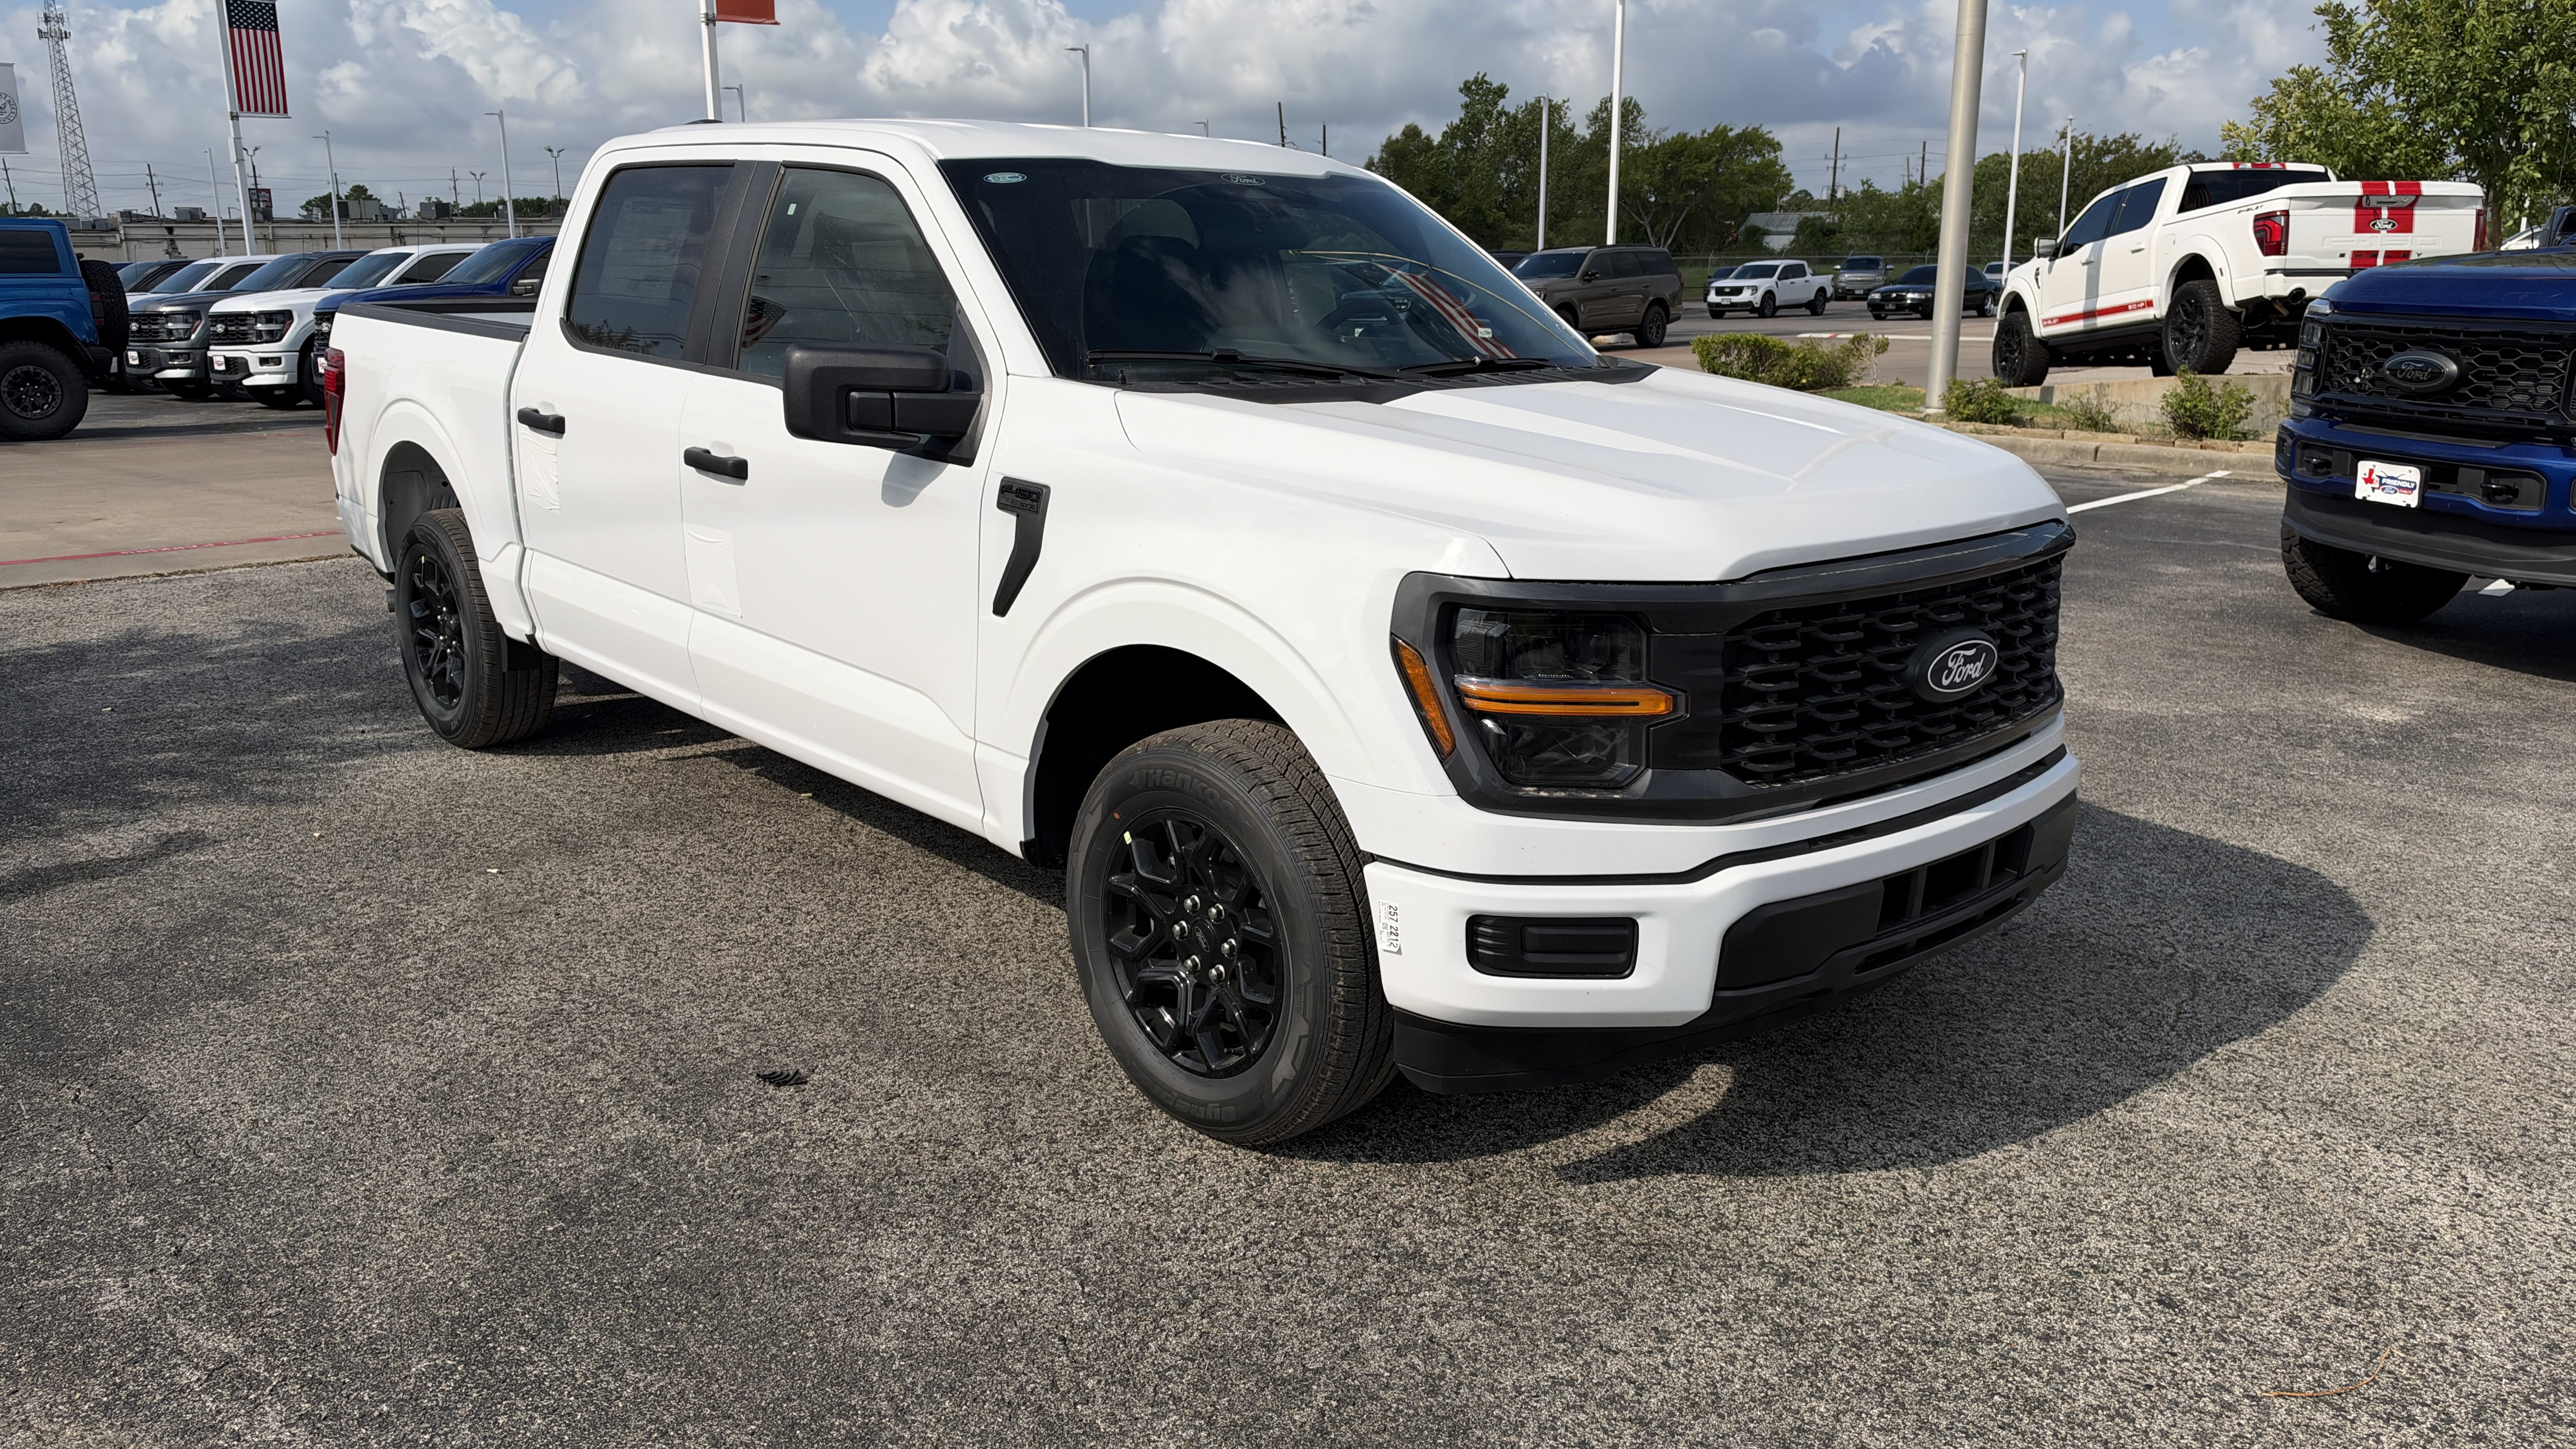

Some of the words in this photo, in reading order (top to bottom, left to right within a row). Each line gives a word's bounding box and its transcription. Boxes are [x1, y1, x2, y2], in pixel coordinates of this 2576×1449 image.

[1229, 175, 1258, 184] Ford
[2374, 221, 2393, 229] Ford
[2397, 362, 2432, 380] Ford
[2382, 478, 2415, 488] FRIENDLY
[1001, 484, 1041, 503] F-150
[1942, 648, 1986, 686] Ford
[1389, 905, 1398, 923] 257
[1389, 925, 1399, 948] 2212
